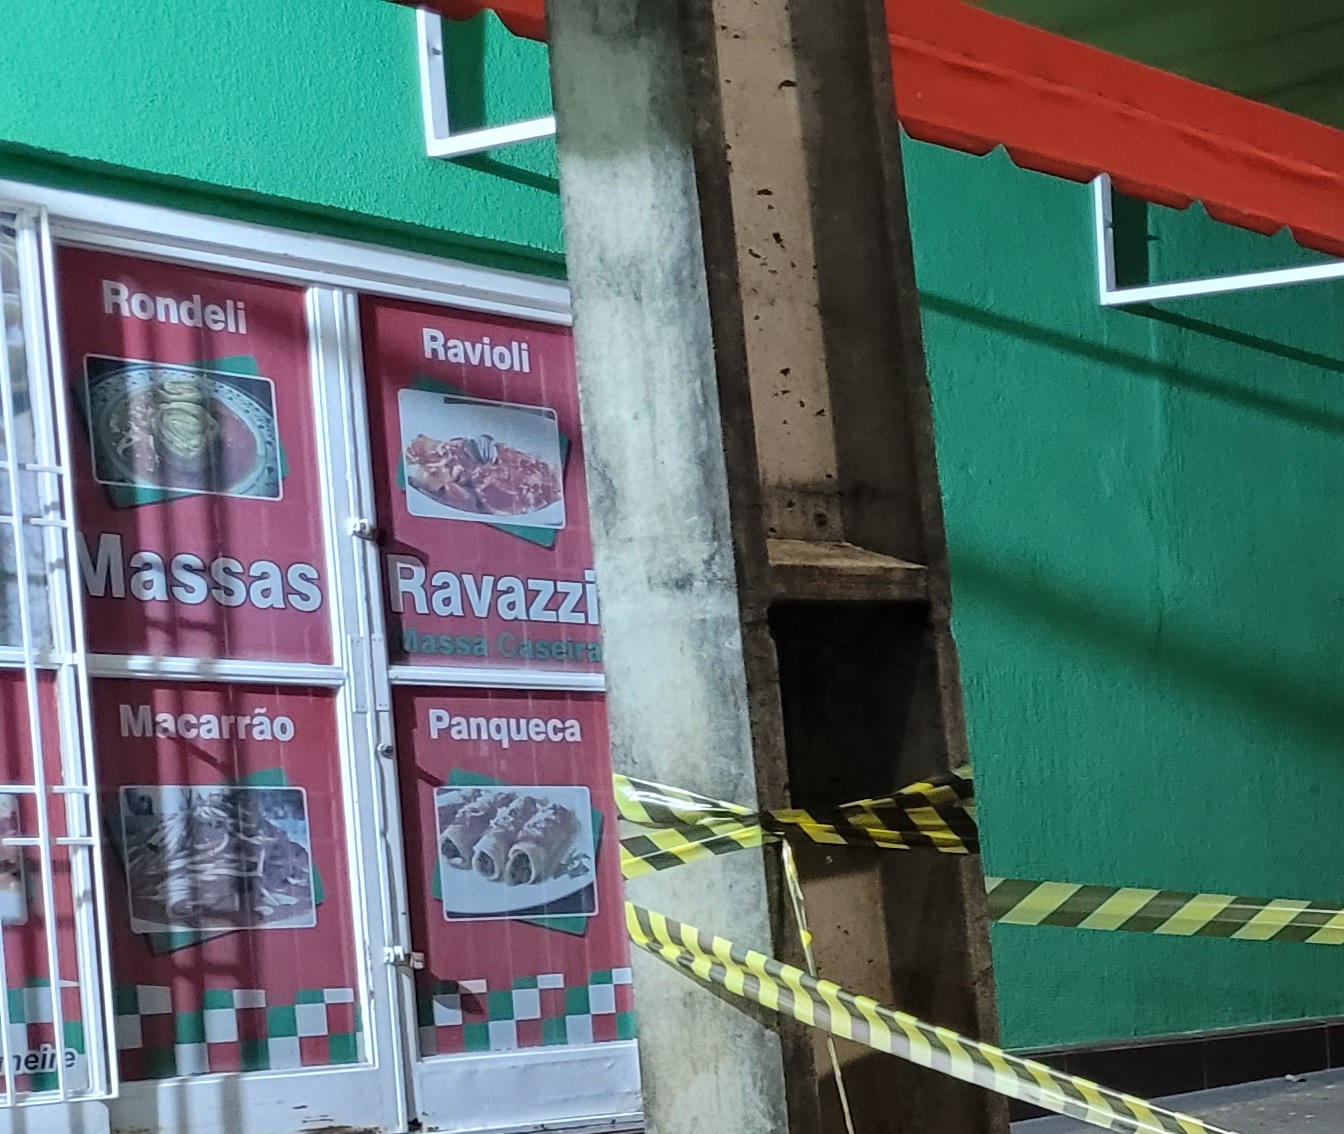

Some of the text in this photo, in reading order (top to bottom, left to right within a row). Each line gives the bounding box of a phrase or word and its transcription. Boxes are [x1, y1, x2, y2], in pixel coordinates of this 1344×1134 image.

[102, 279, 248, 335] Rondeli
[422, 327, 531, 374] Ravioli
[76, 531, 323, 613] Massas
[386, 553, 600, 626] Ravazzi
[400, 626, 603, 663] Massa Caseira
[118, 704, 296, 742] Macarrão
[428, 708, 582, 749] Panqueca
